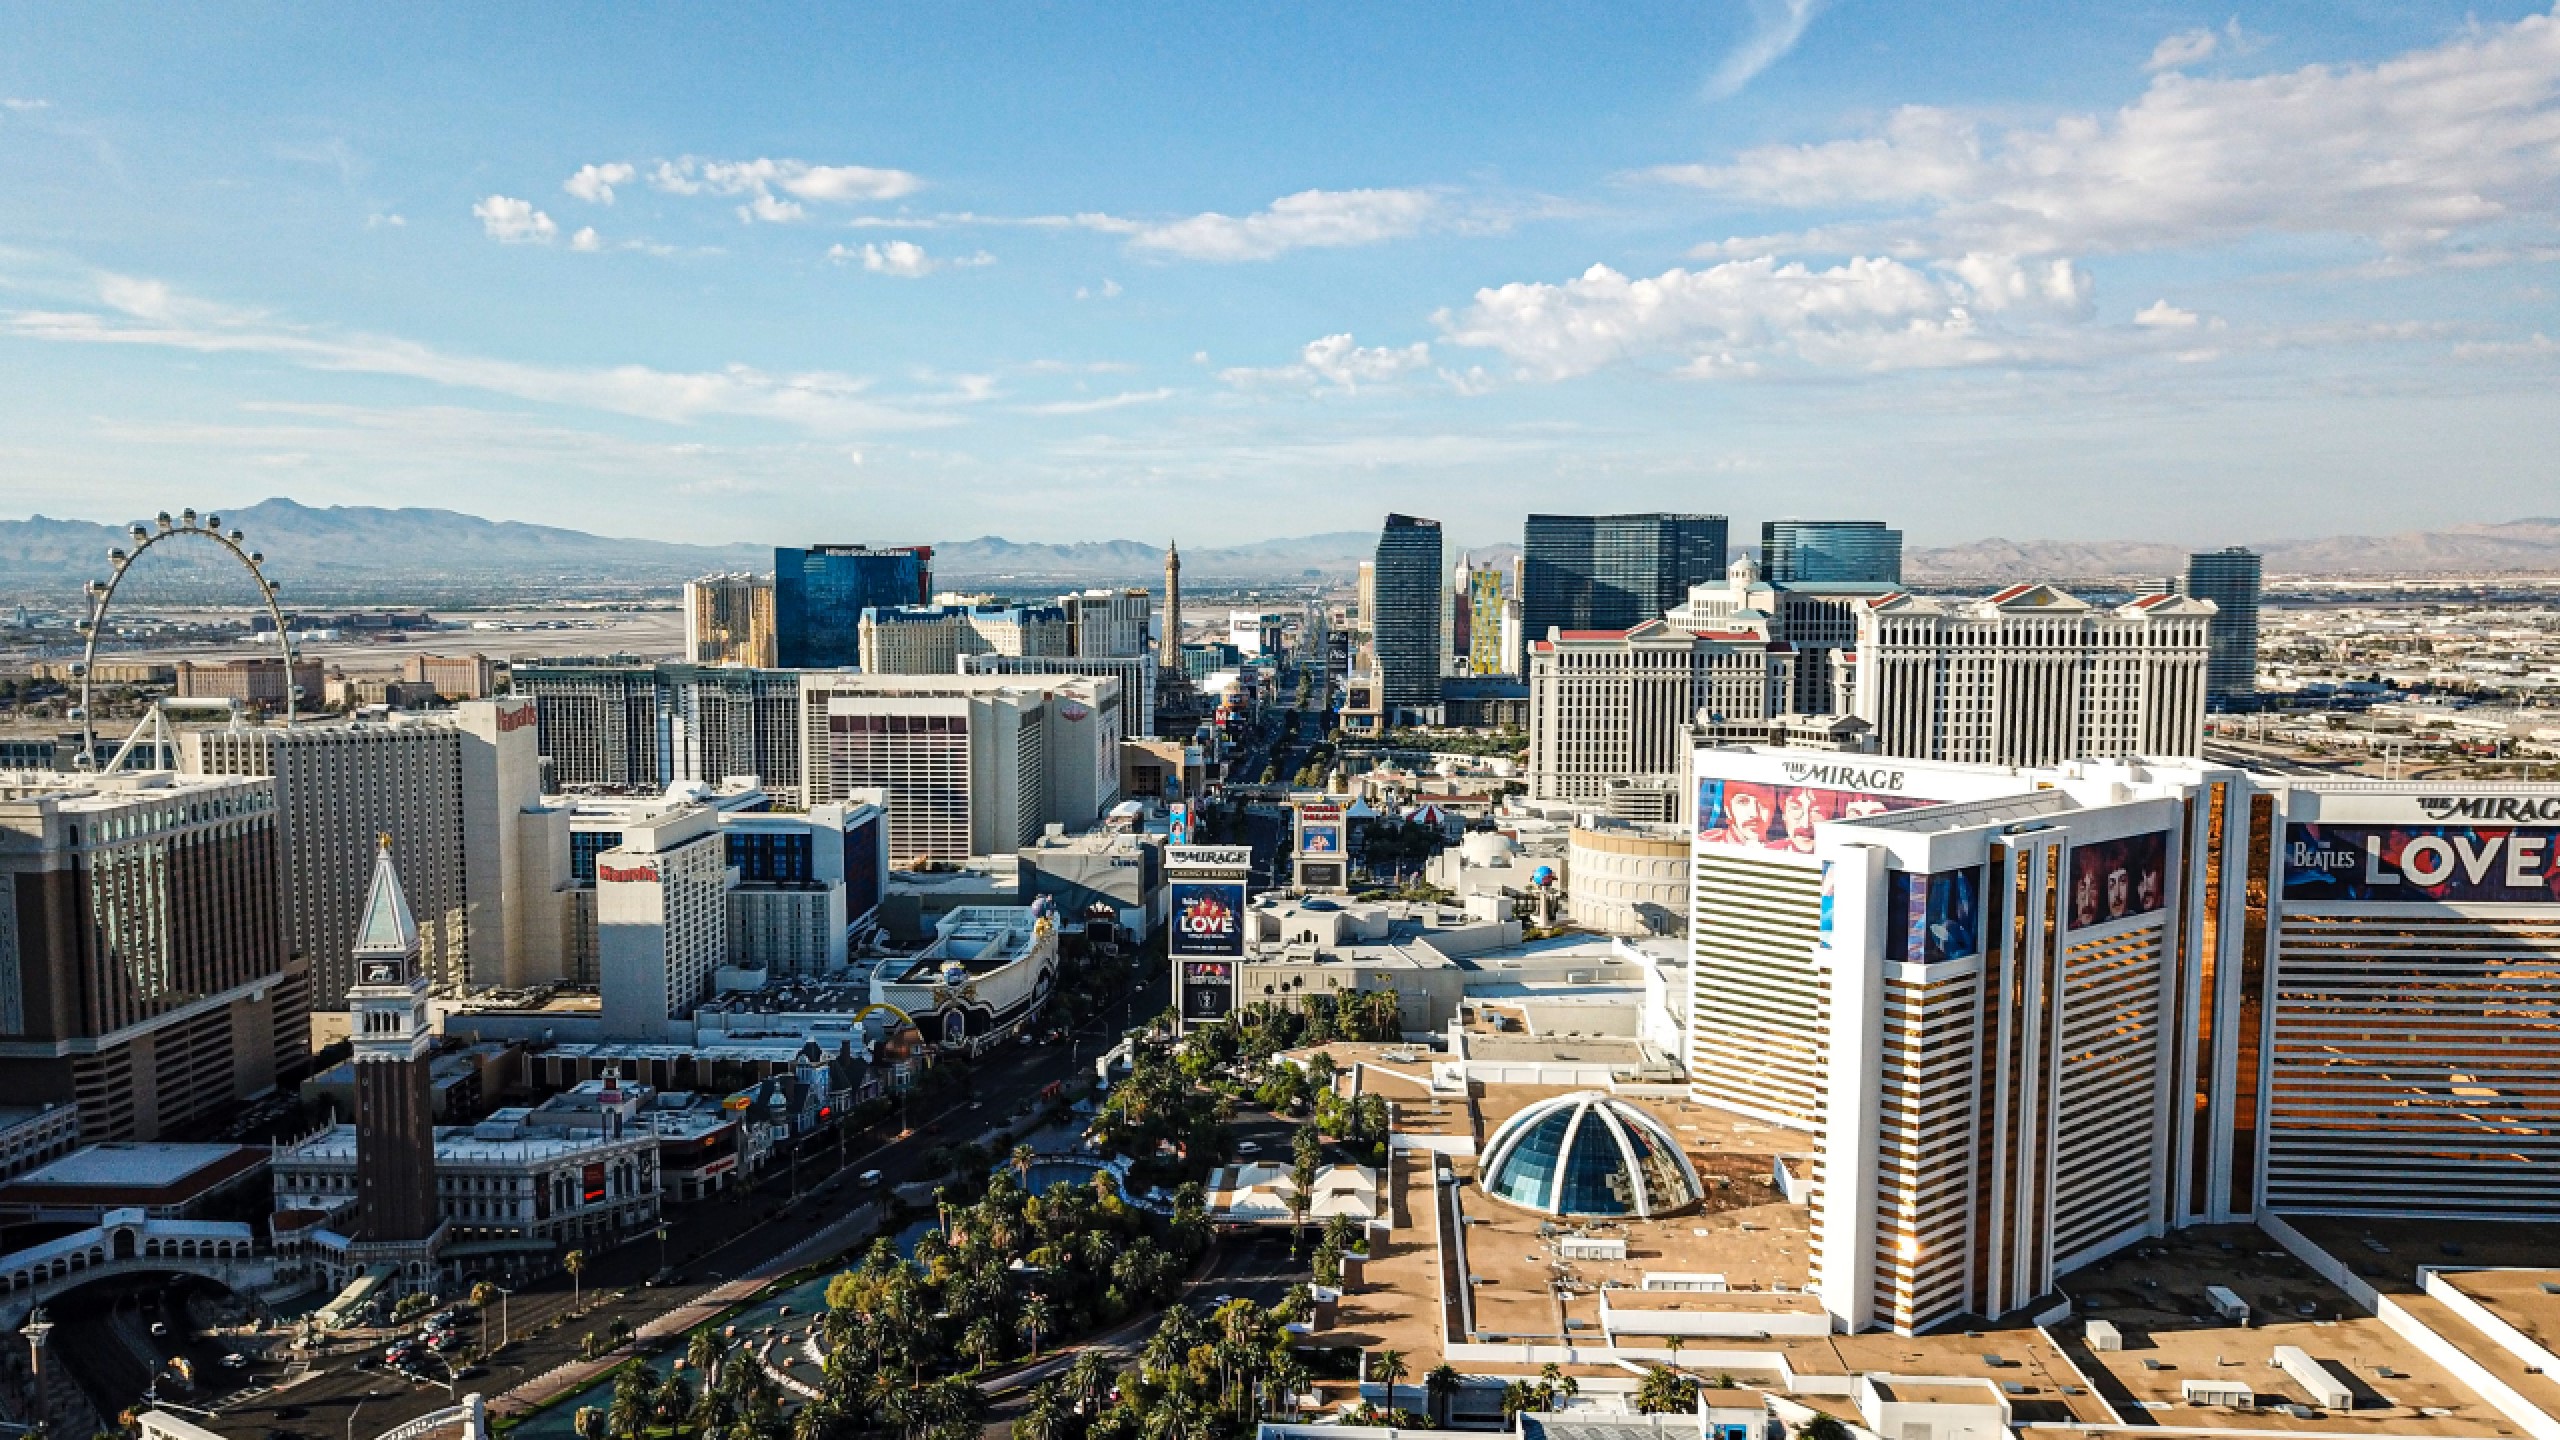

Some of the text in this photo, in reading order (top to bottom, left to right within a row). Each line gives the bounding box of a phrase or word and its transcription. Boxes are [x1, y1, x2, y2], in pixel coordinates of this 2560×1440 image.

[1782, 762, 1905, 790] THE MIRAGE
[2416, 797, 2560, 822] THE MIRAG
[1174, 852, 1246, 864] MIRAGE
[2294, 835, 2547, 887] BEATLES LOVE
[1181, 915, 1235, 933] LOVE
